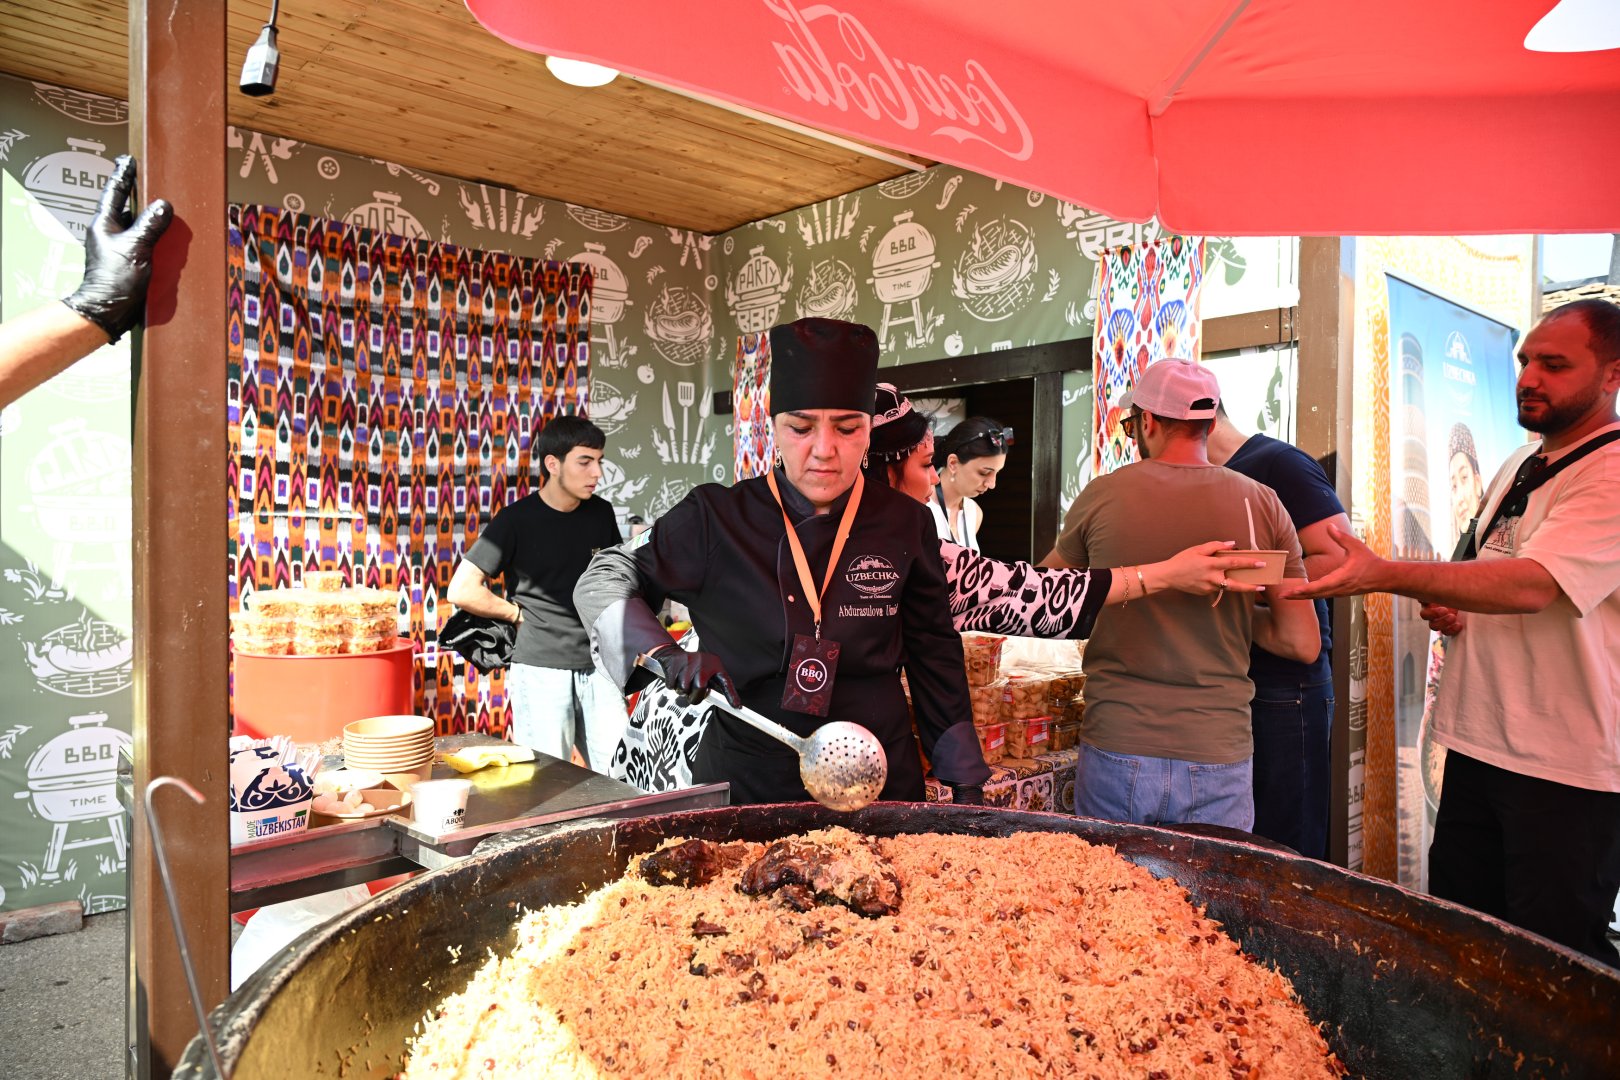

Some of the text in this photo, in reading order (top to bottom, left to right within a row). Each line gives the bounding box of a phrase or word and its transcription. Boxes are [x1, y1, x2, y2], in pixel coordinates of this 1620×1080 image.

[890, 236, 917, 255] BBQ
[740, 259, 777, 290] PARTY
[892, 281, 912, 291] TIME
[845, 571, 900, 582] UZBECHKA
[800, 667, 823, 682] BBQ
[65, 744, 114, 764] BBQ
[70, 795, 107, 807] TIME
[246, 820, 256, 839] MADE
[255, 815, 307, 837] UZBEKISTAN
